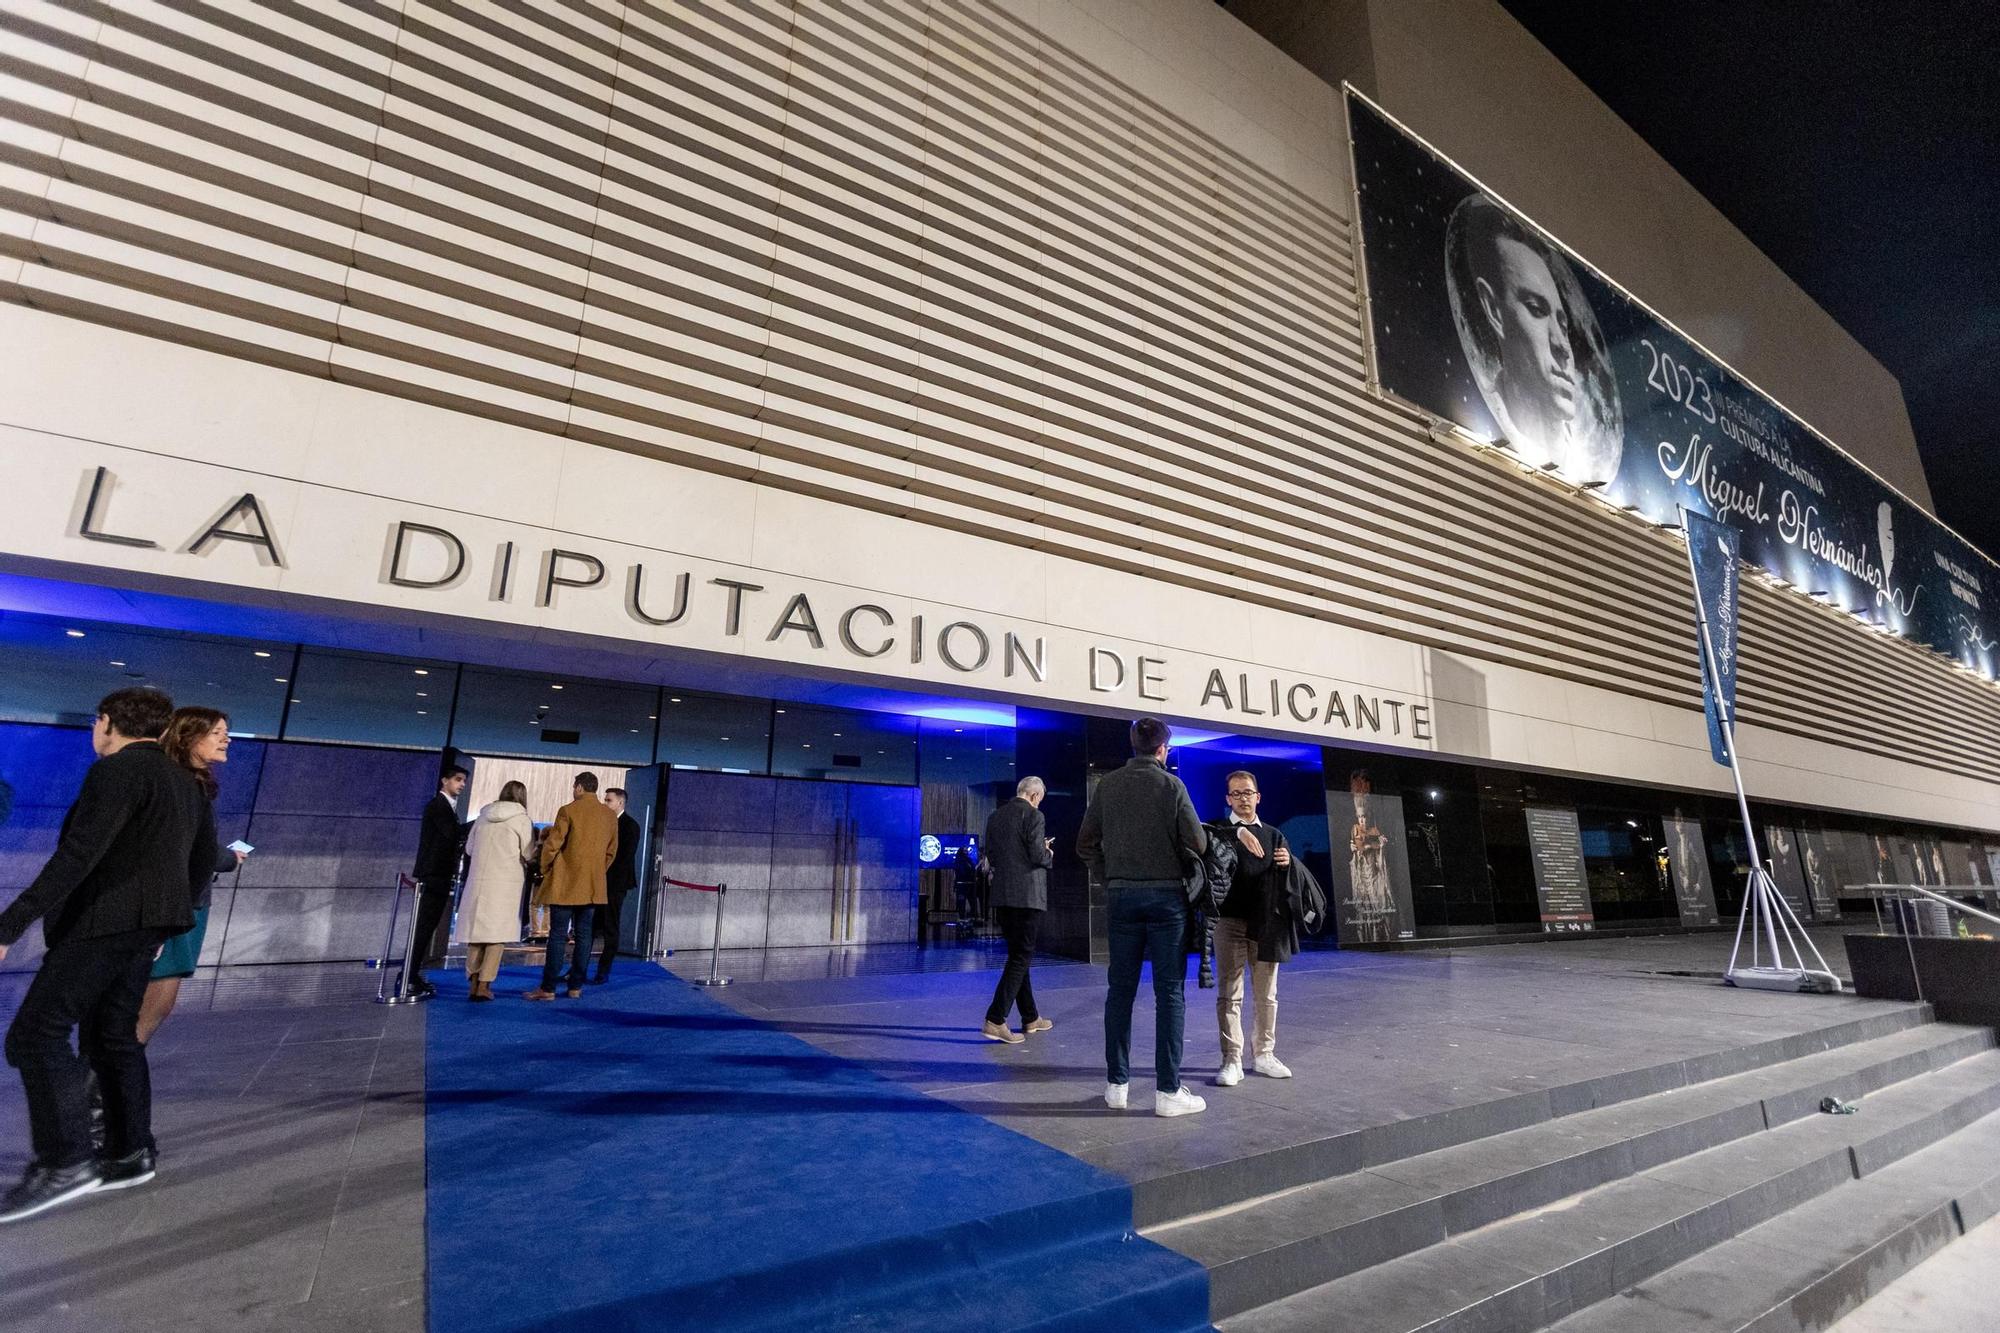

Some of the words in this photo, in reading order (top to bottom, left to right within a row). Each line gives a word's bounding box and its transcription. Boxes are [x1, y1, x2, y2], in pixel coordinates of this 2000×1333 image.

[1641, 339, 1716, 424] 2023
[1657, 434, 1770, 524] Miguel
[1778, 489, 1892, 608] Hernández
[1720, 416, 1771, 462] CULTURA
[1770, 447, 1826, 498] ALICANTINA
[79, 465, 282, 567] LA
[389, 520, 1048, 683] DIPUTACION
[1089, 645, 1169, 702] DE
[1200, 668, 1434, 740] ALICANTE
